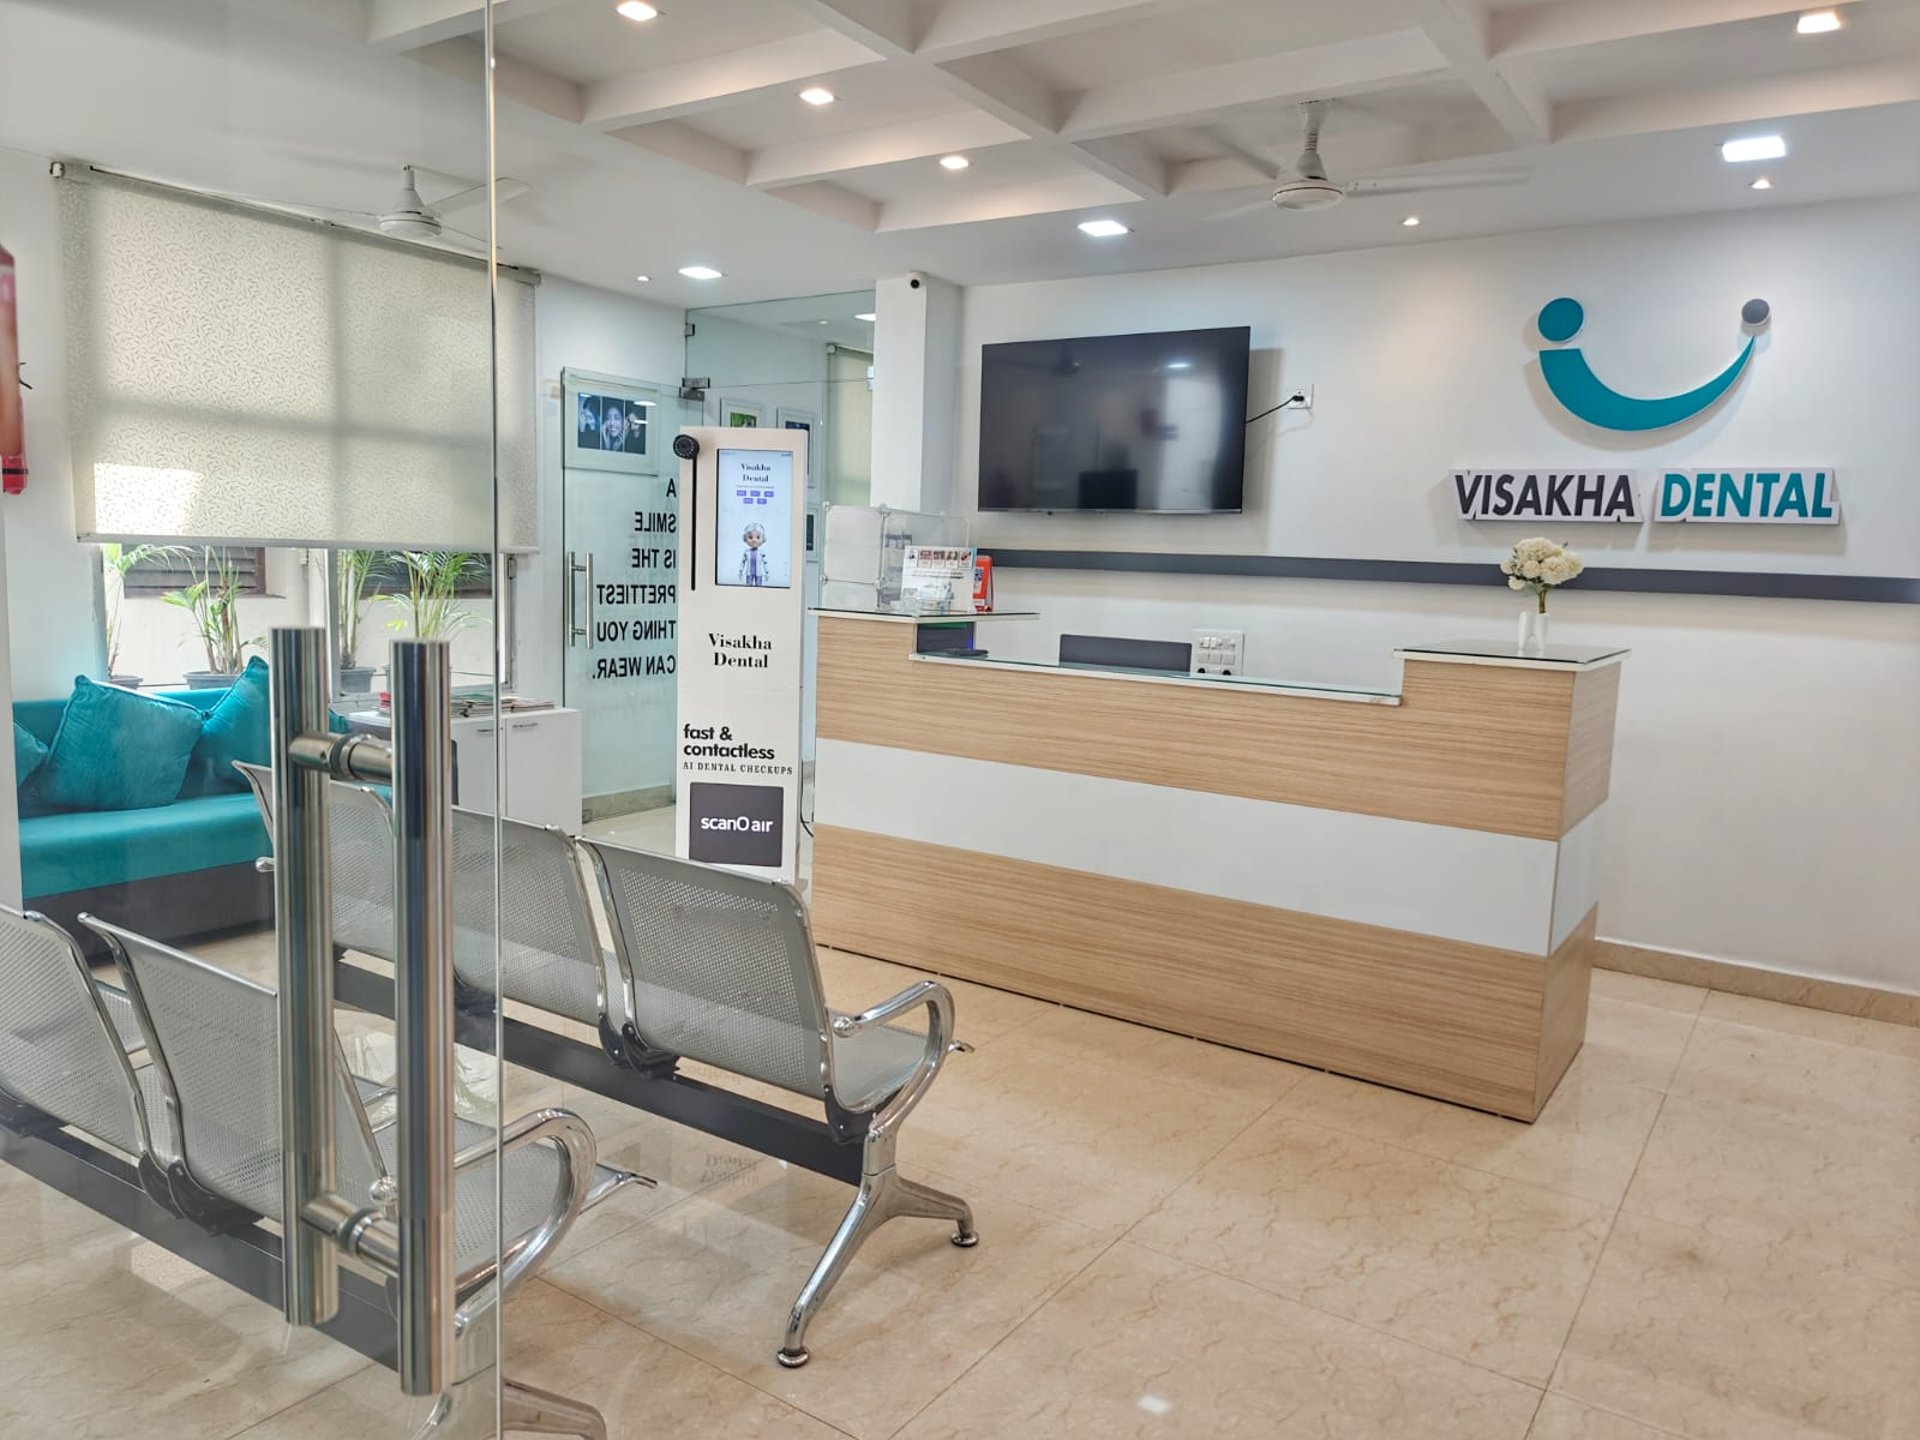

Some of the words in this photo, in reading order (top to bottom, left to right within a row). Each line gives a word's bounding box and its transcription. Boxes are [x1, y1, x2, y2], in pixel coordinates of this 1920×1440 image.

[1455, 474, 1635, 517] VISAKHA
[1660, 472, 1832, 518] DENTAL
[708, 633, 772, 650] Visakha
[713, 652, 768, 668] Dental
[683, 724, 715, 740] fast
[719, 726, 733, 741] &
[683, 743, 775, 760] contactless
[683, 762, 693, 770] AI
[697, 762, 737, 773] DENTAL
[740, 764, 793, 775] CHECKUPS
[700, 816, 750, 831] scanO
[751, 818, 774, 833] air
